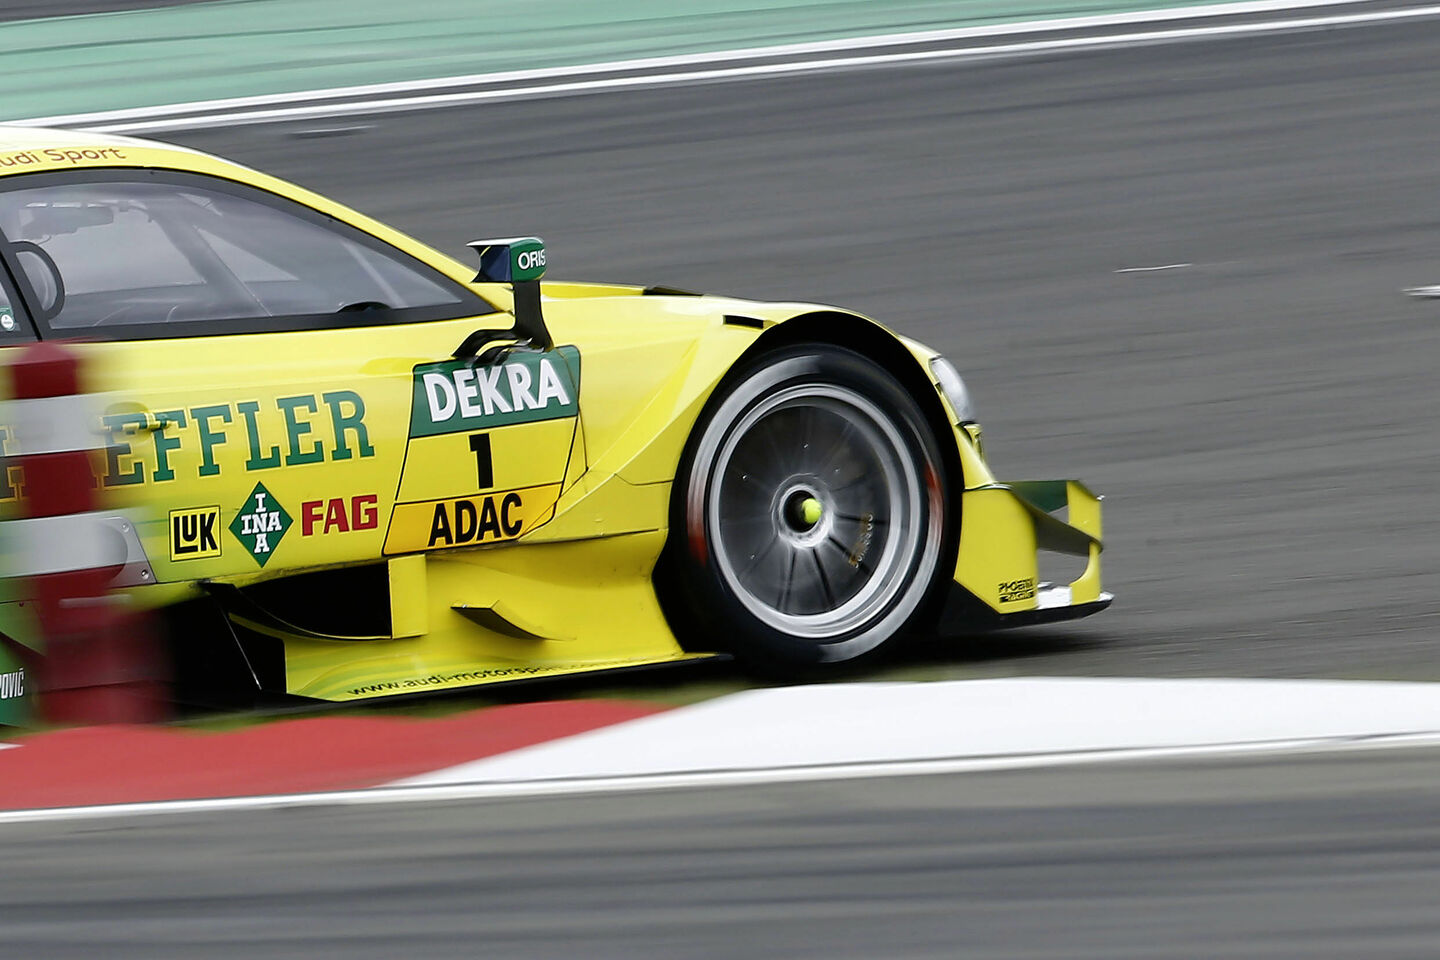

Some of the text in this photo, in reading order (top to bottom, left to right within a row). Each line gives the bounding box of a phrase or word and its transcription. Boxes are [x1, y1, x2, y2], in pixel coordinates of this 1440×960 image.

[43, 147, 127, 164] Sport
[517, 248, 547, 270] ORIS
[422, 358, 571, 423] DEKRA
[468, 432, 494, 490] 1
[302, 494, 379, 537] FAG
[427, 492, 524, 548] ADAC
